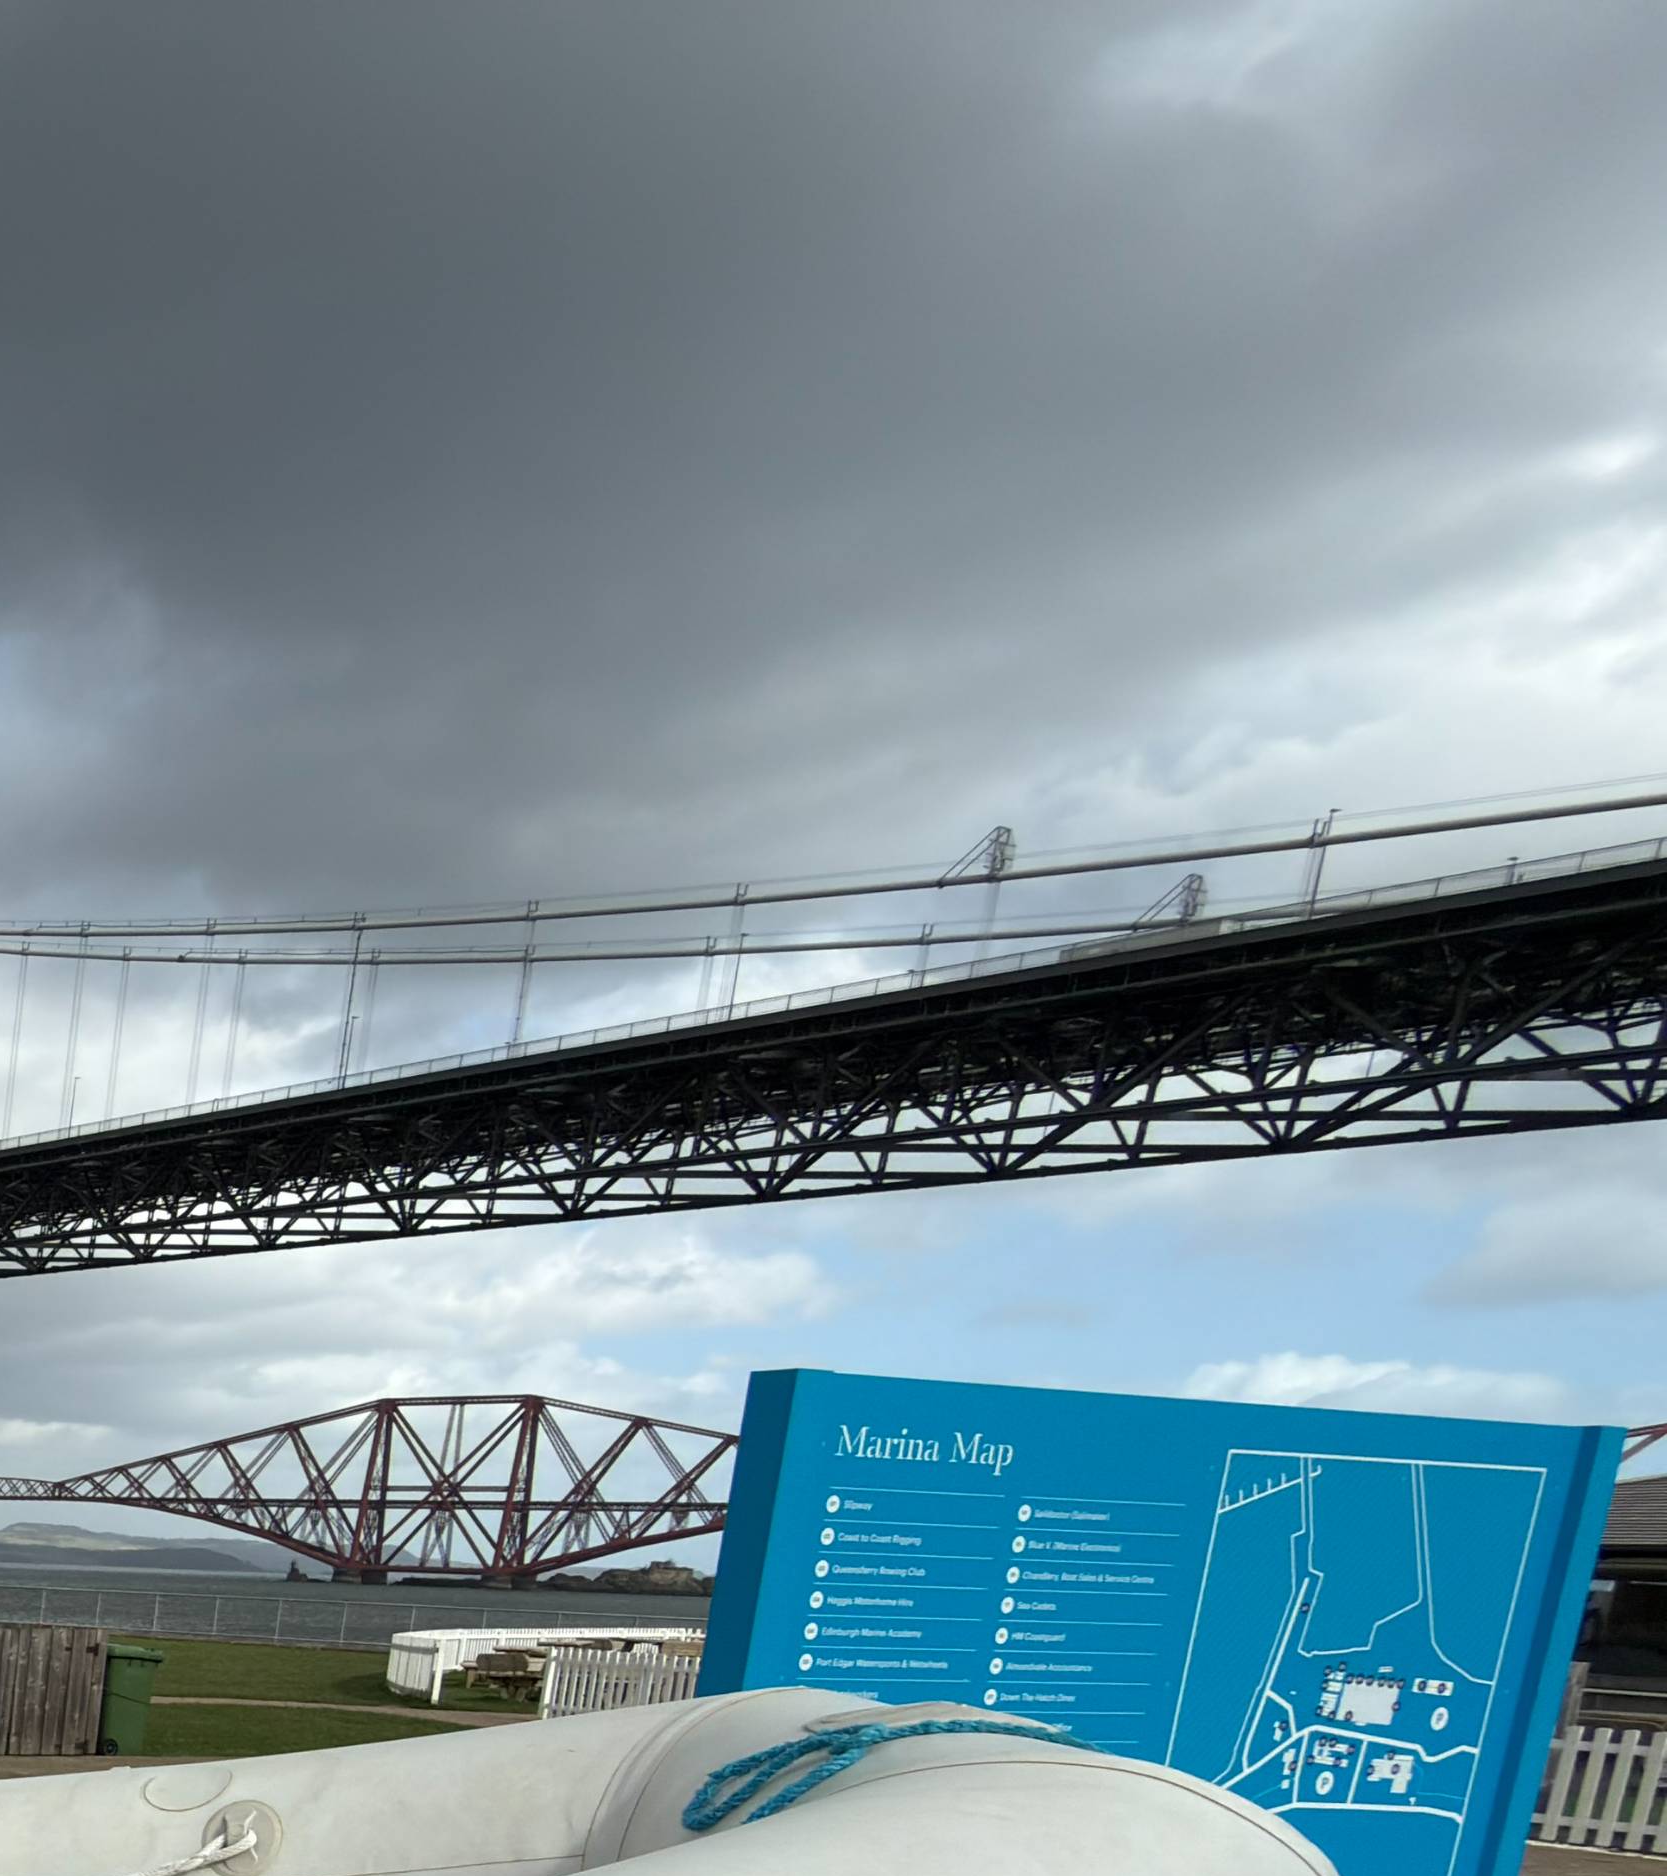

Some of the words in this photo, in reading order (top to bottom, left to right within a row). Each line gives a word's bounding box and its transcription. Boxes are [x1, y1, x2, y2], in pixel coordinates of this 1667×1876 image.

[834, 1425, 940, 1462] Marina
[948, 1431, 1014, 1476] Map
[843, 1499, 873, 1511] Slipway
[860, 1533, 869, 1543] to
[907, 1567, 926, 1577] Club
